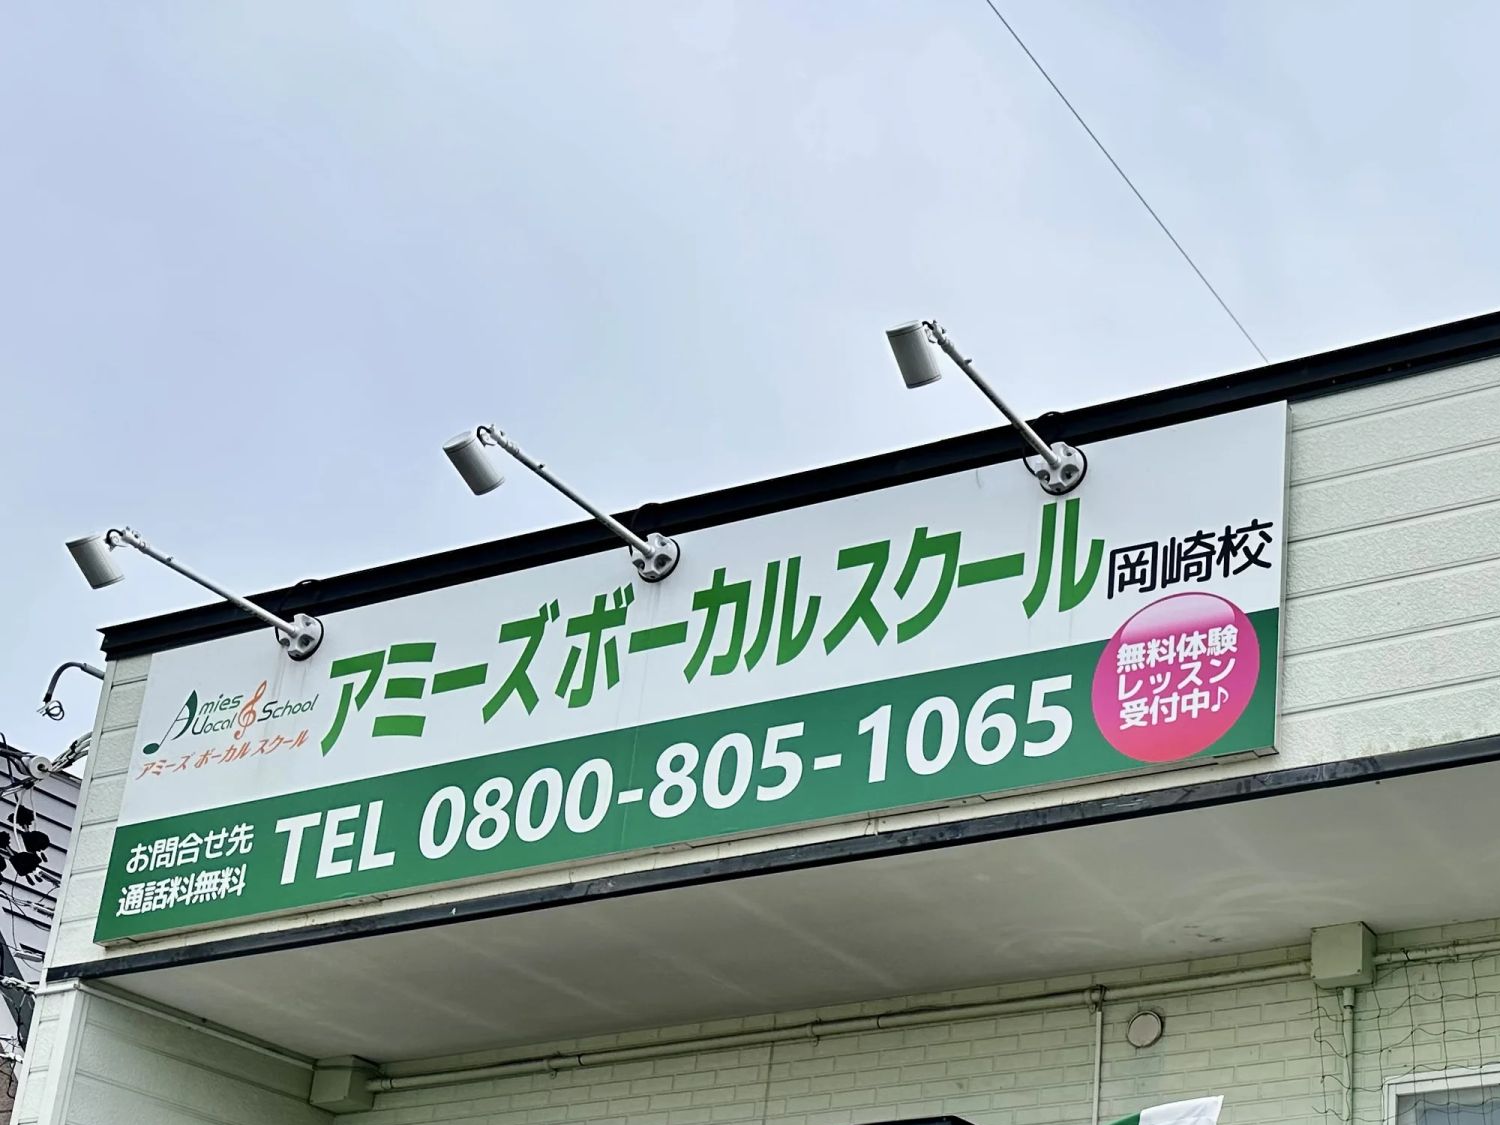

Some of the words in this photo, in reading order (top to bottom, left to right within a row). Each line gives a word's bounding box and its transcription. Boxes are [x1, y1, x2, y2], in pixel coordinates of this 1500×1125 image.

[320, 497, 1105, 757] アミーズボーカルスクール
[1107, 519, 1275, 600] 岡崎校
[1116, 624, 1239, 674] 無料体験
[1118, 658, 1236, 701] レッスン
[257, 694, 319, 722] School
[135, 752, 195, 780] アミーズ
[194, 741, 251, 769] ボーカル
[251, 729, 309, 757] スクール
[274, 799, 396, 885] TEL
[418, 673, 1074, 861] 0800-805-1065
[125, 822, 255, 874] お問合せ先
[116, 863, 246, 918] 通話料無料
